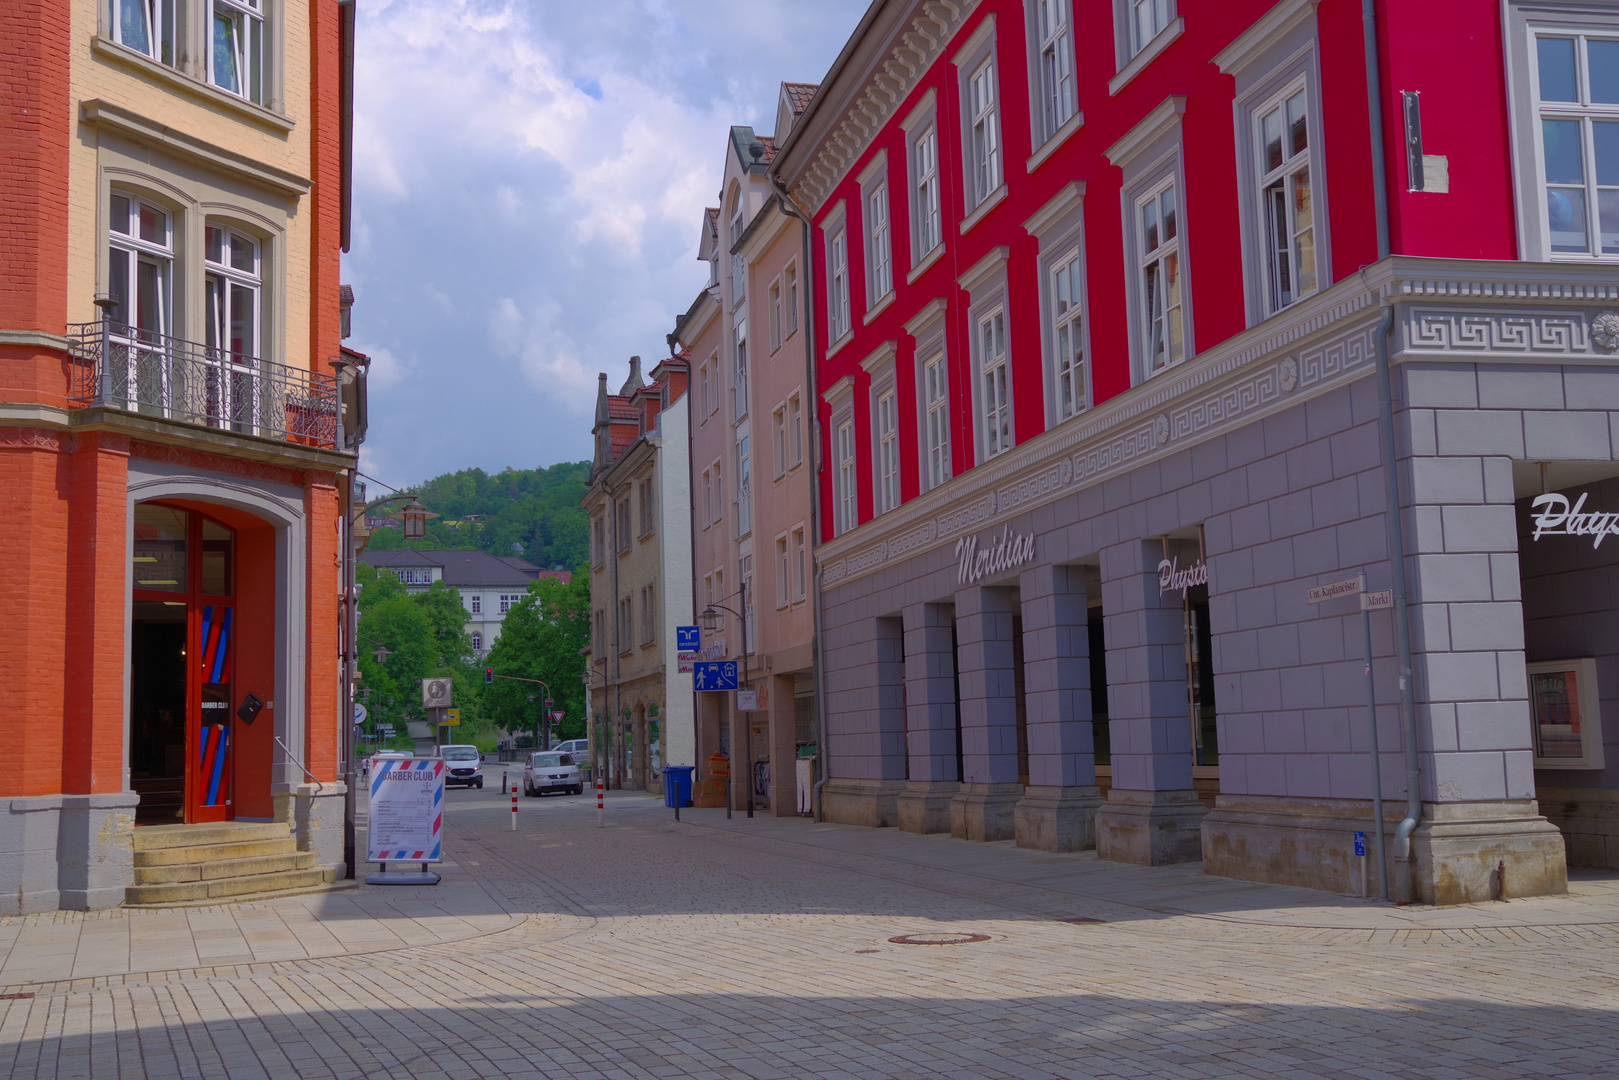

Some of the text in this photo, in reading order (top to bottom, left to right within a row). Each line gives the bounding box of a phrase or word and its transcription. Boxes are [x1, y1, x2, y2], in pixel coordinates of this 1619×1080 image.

[955, 524, 1035, 585] Meridian
[1158, 555, 1208, 600] Physio
[1322, 582, 1358, 597] Kaplaneistr.
[1368, 593, 1389, 606] Markt
[201, 701, 229, 709] BARBER CLUB
[382, 771, 433, 781] BARBER CLUB
